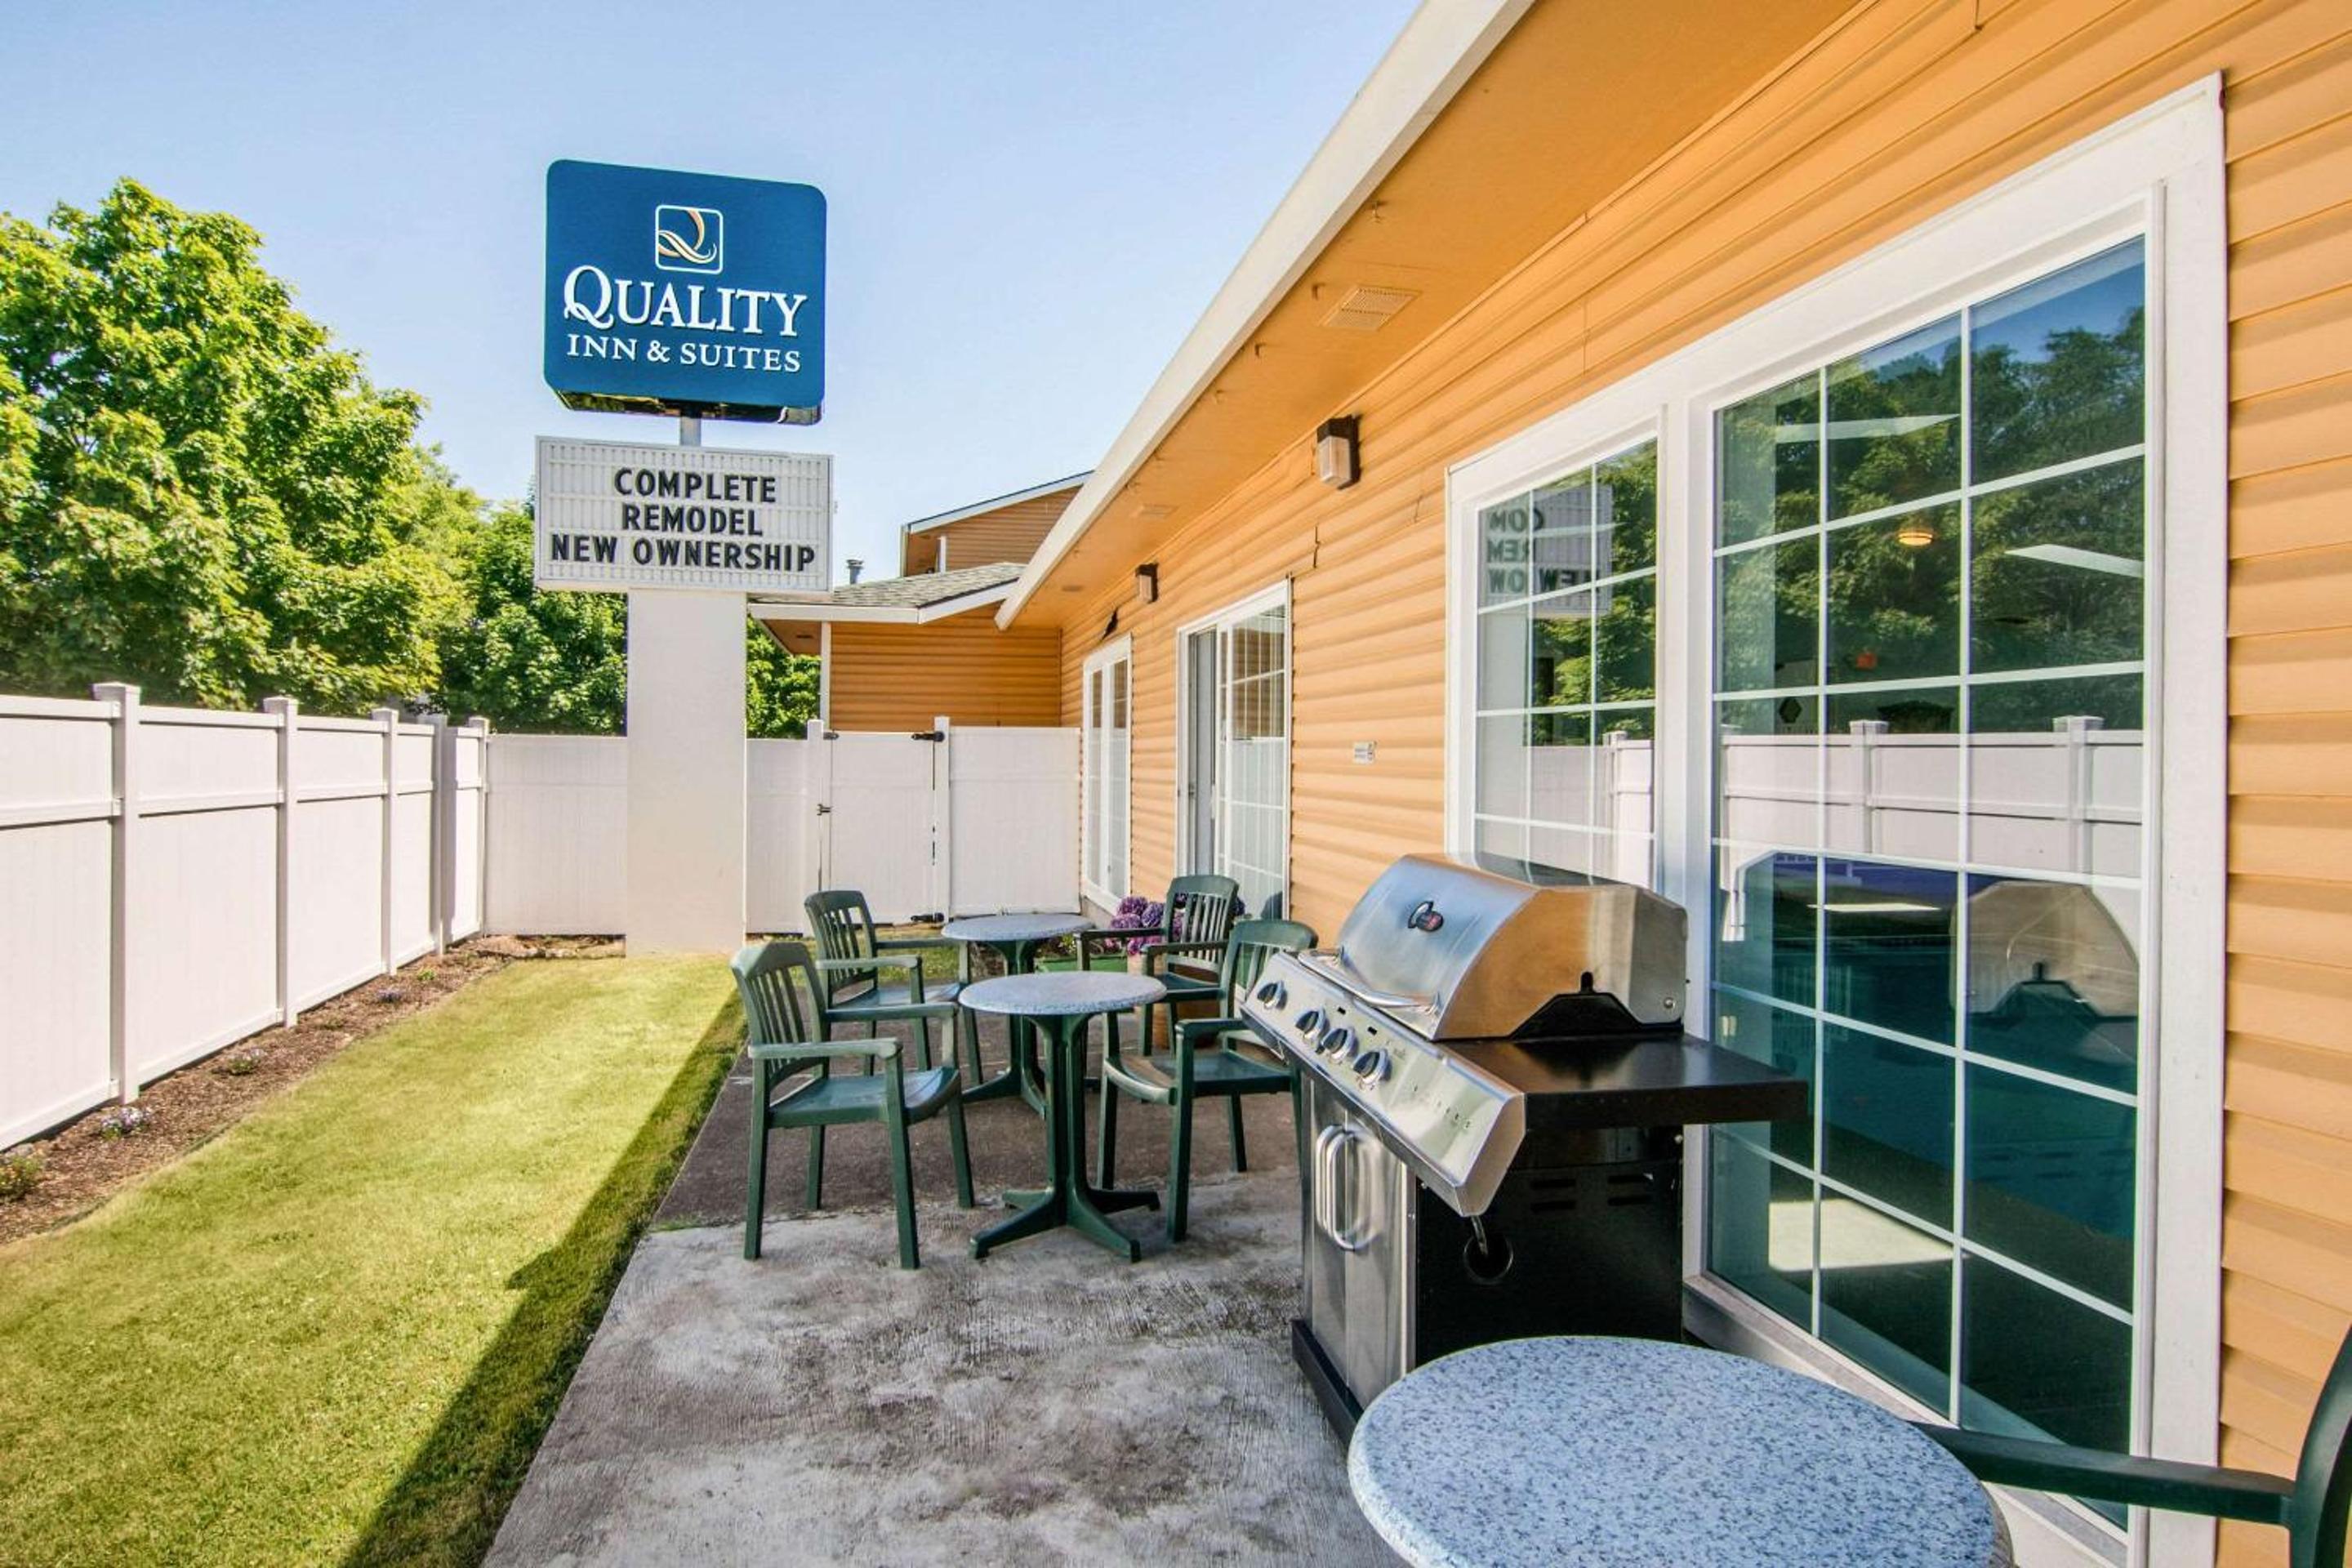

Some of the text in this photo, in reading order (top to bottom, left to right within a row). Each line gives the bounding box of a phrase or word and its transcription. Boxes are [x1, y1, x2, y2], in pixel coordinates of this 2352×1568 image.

[564, 265, 808, 337] QUALITY
[567, 333, 801, 373] INN & SUITES
[614, 467, 777, 503] COMPLETE
[621, 503, 764, 537] REMODEL
[551, 533, 815, 572] NEW OWNERSHIP
